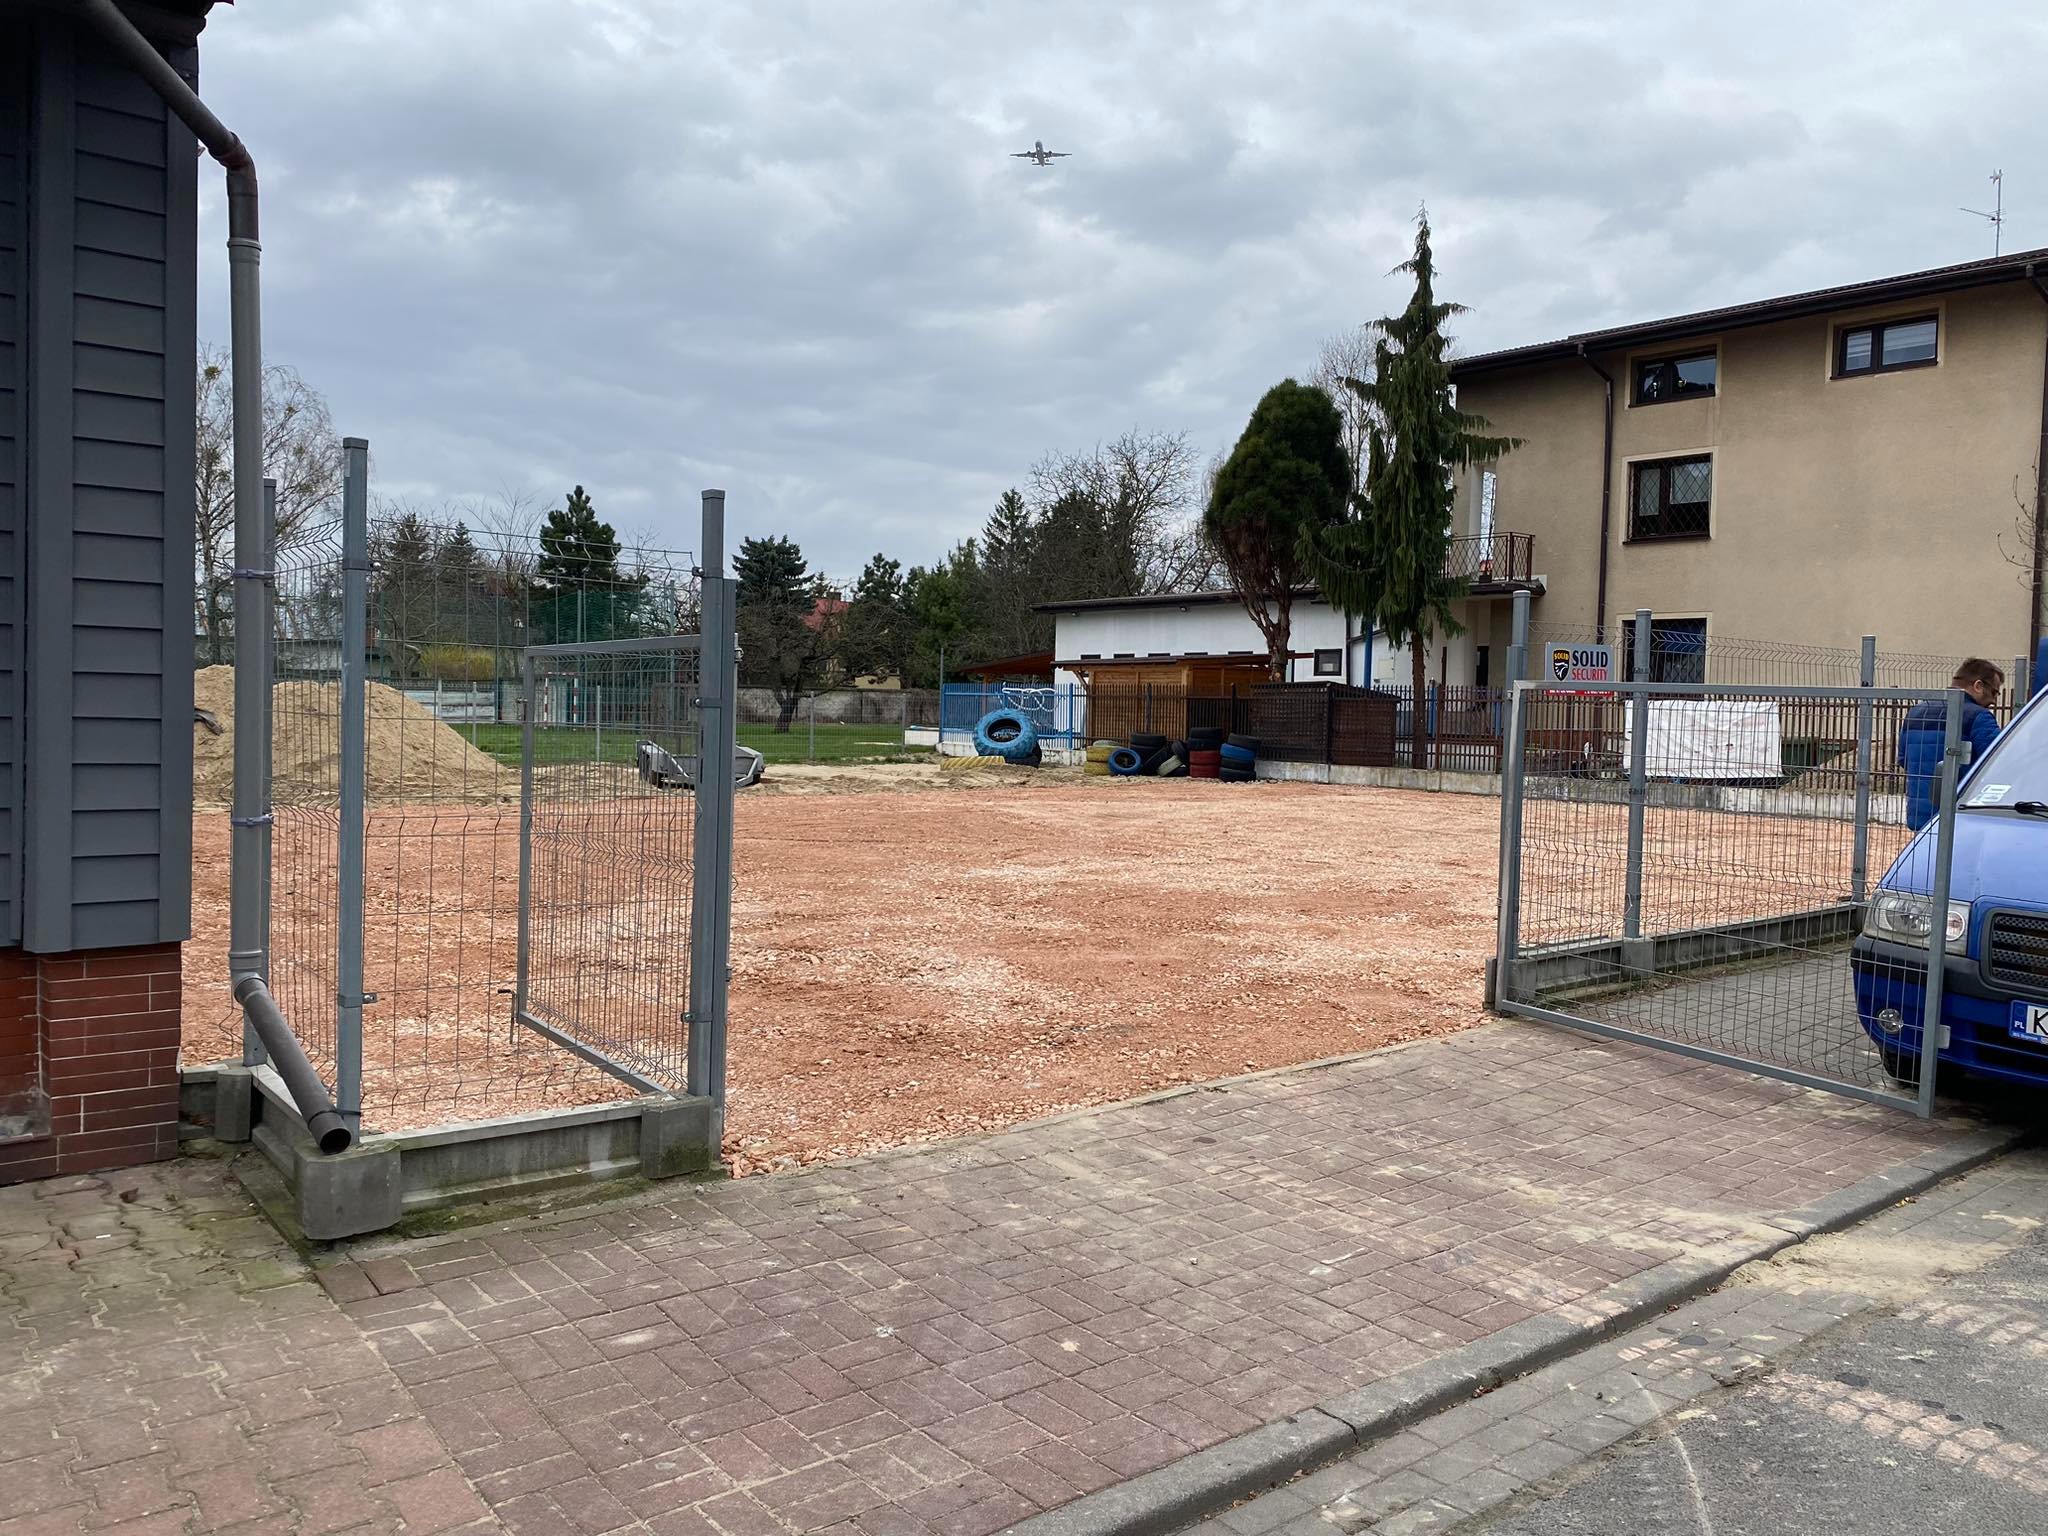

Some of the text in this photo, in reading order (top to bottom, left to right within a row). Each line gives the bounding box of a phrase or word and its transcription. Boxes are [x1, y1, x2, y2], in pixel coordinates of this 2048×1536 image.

[1572, 650, 1608, 667] SOLID
[1572, 668, 1607, 680] SECURITY
[2014, 1020, 2025, 1029] PL
